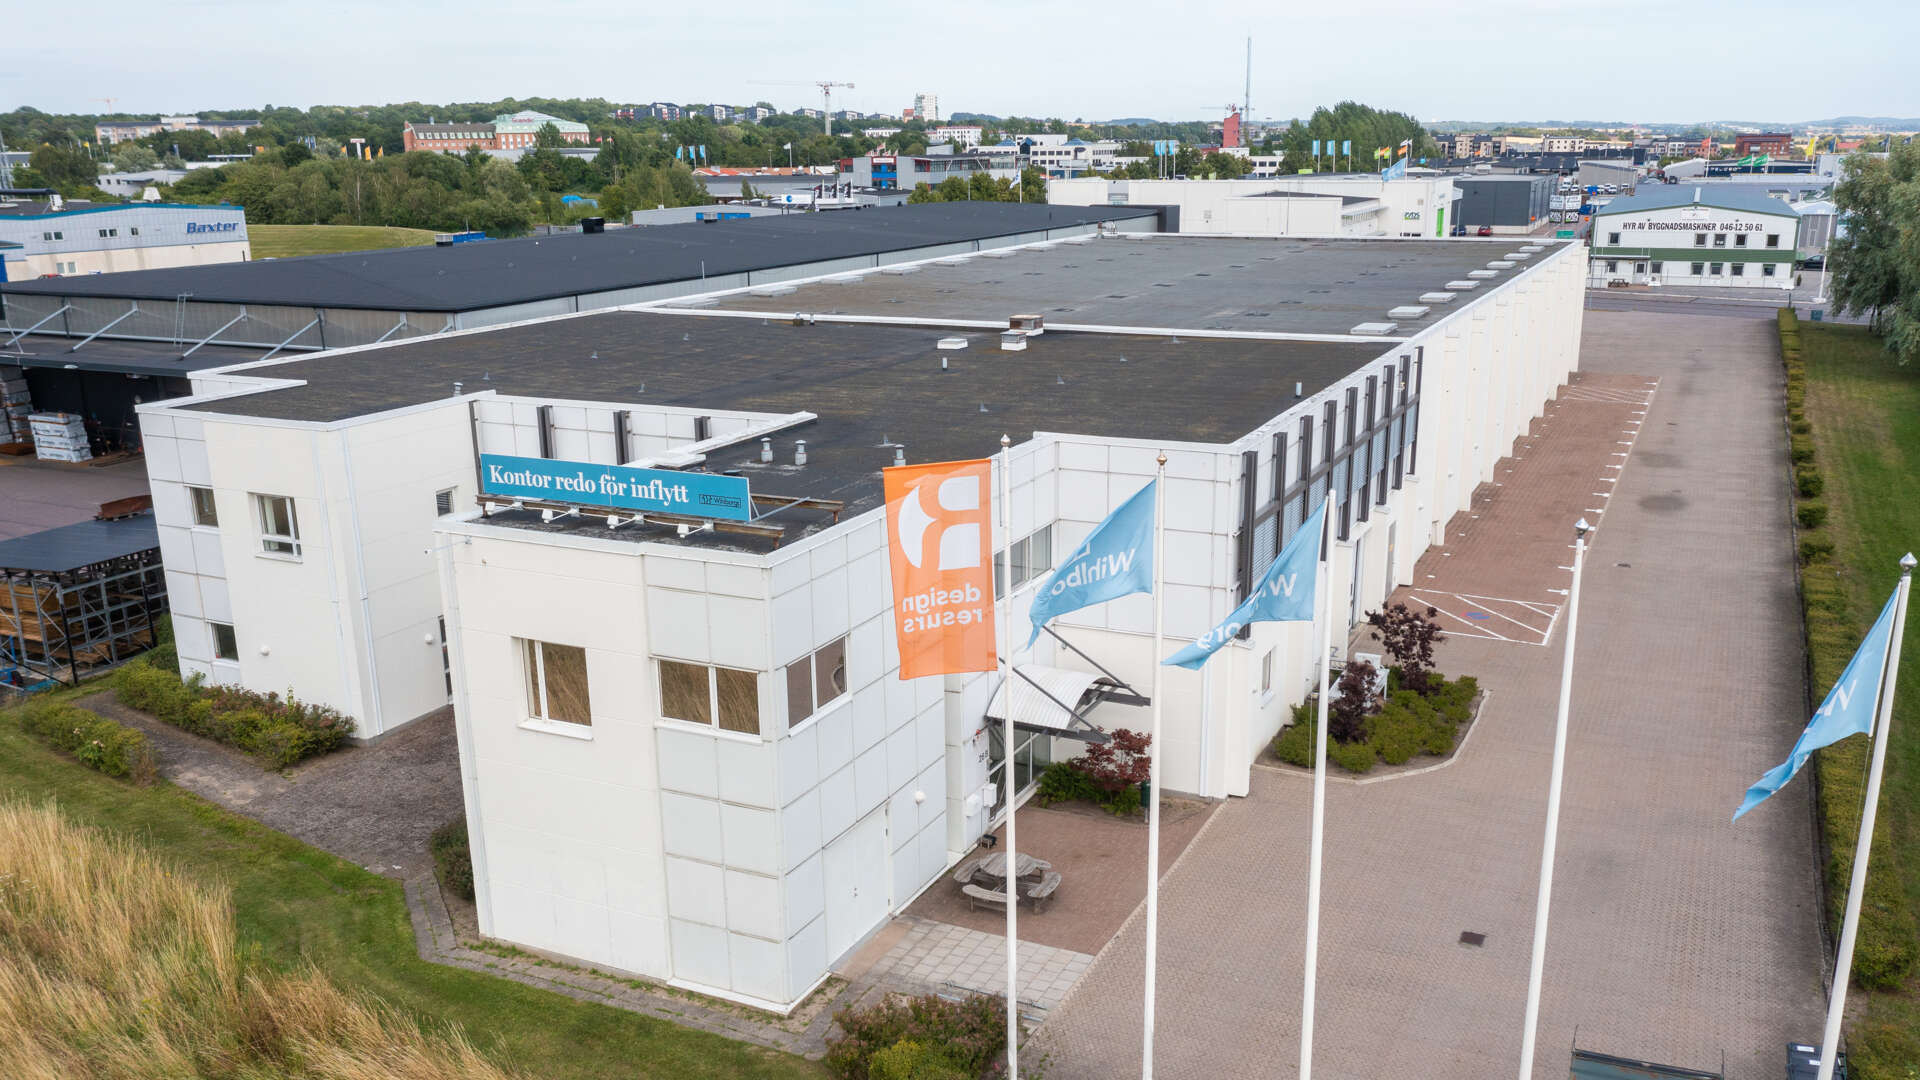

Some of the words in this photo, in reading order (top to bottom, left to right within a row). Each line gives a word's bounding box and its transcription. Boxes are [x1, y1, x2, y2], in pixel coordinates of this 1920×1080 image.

[187, 222, 240, 233] Baxter
[1622, 222, 1637, 230] HYR
[1637, 222, 1647, 230] AV
[1648, 222, 1717, 231] BYGGNADSMASKINER
[1744, 223, 1754, 231] 50
[1755, 223, 1763, 231] 61
[488, 464, 551, 489] Kontor
[555, 471, 596, 494] redo
[599, 473, 628, 497] för
[630, 476, 690, 507] inflytt
